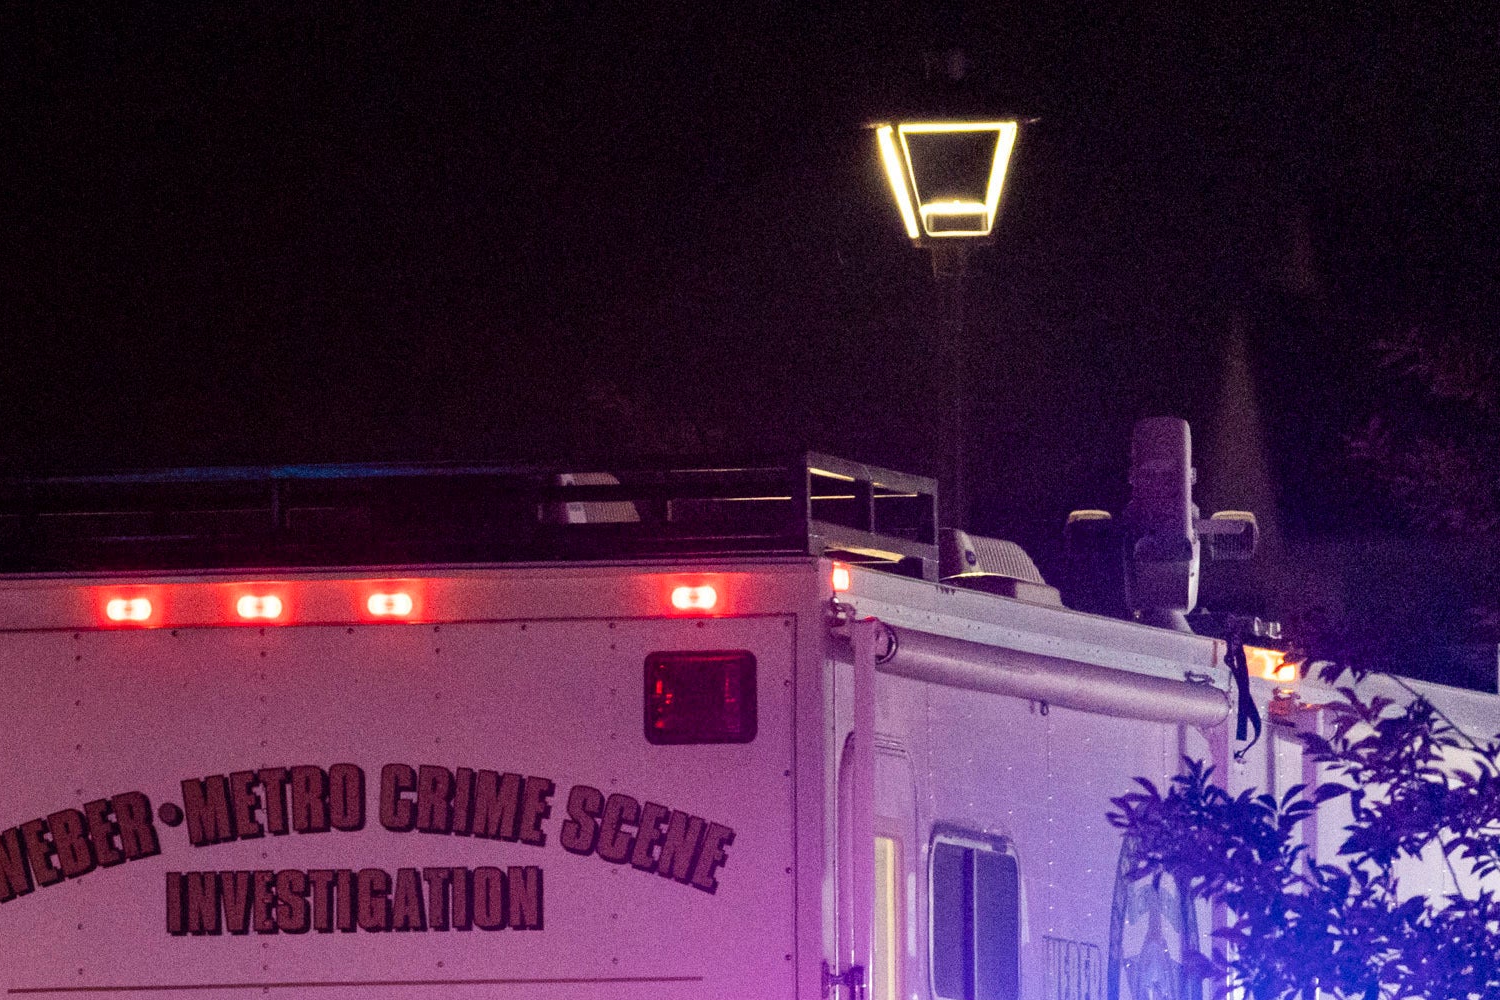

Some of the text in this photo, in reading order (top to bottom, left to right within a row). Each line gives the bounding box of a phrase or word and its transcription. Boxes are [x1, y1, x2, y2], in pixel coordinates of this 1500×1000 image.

[379, 763, 555, 847] CRIME
[560, 784, 736, 894] SCENE
[165, 865, 544, 935] INVESTIGATION
